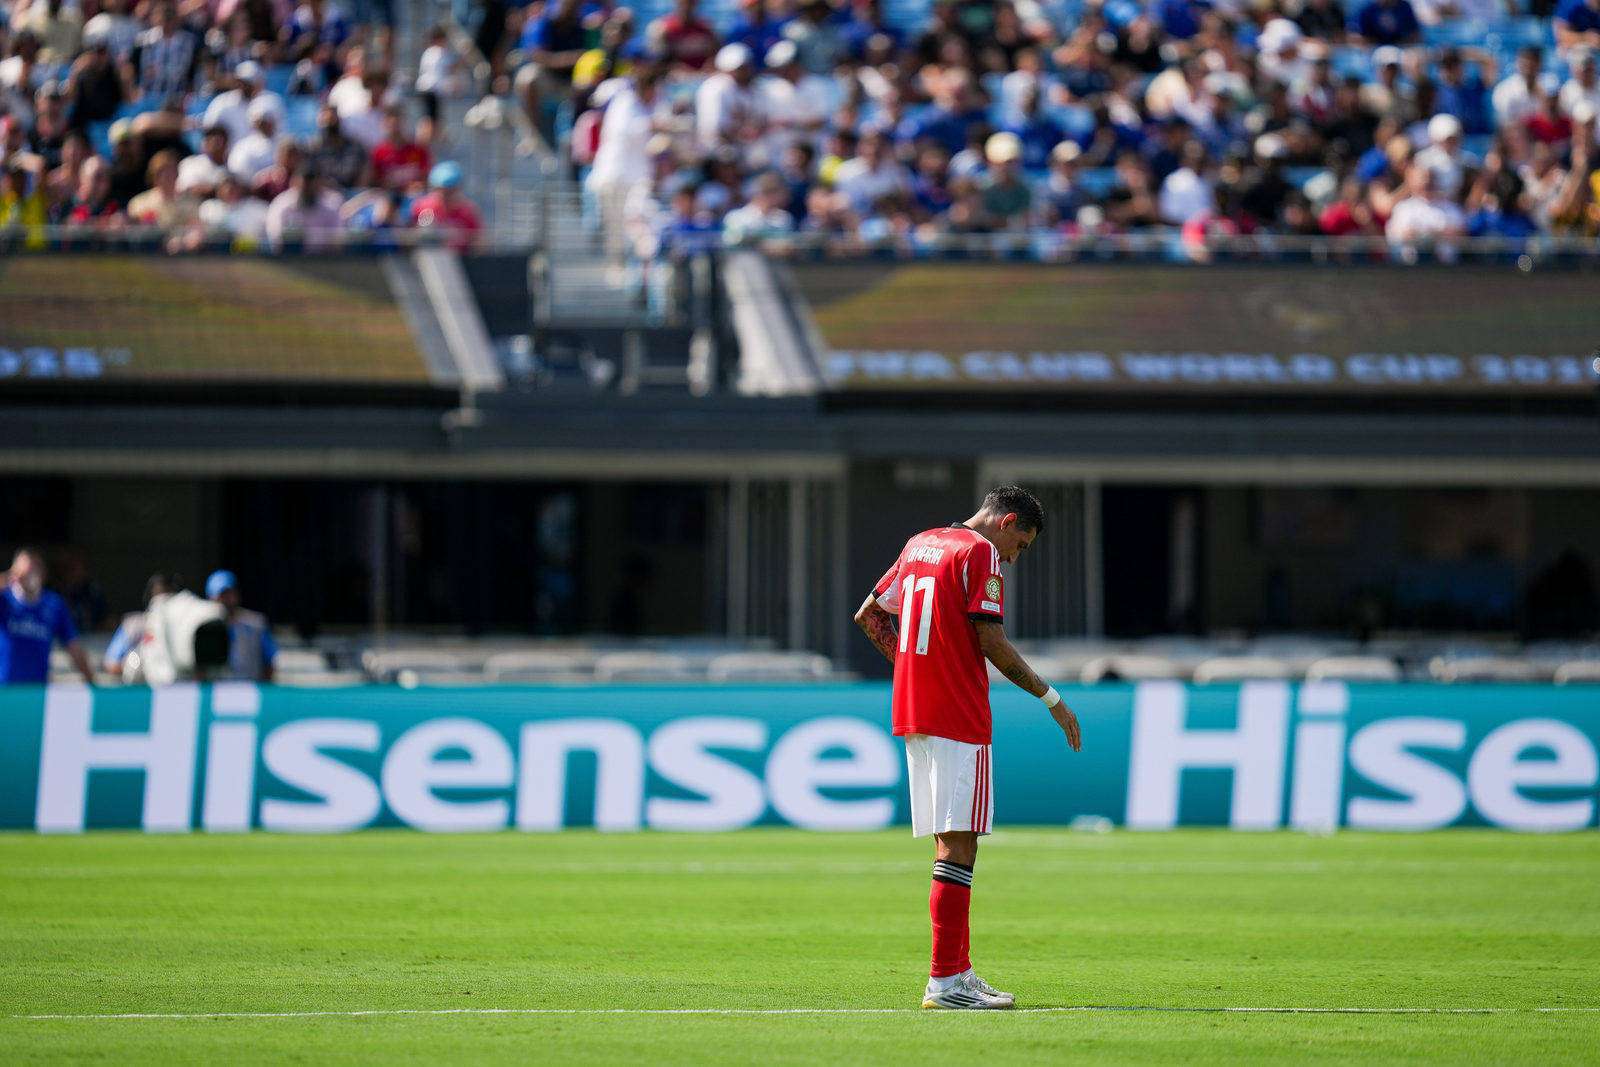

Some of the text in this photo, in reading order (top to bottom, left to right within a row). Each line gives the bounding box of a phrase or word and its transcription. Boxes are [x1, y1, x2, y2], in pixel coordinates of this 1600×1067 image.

[1120, 353, 1336, 383] WORLD
[1346, 353, 1463, 384] CUP
[900, 573, 936, 655] 11
[36, 683, 899, 833] Hisense
[1125, 680, 1598, 832] Hise
